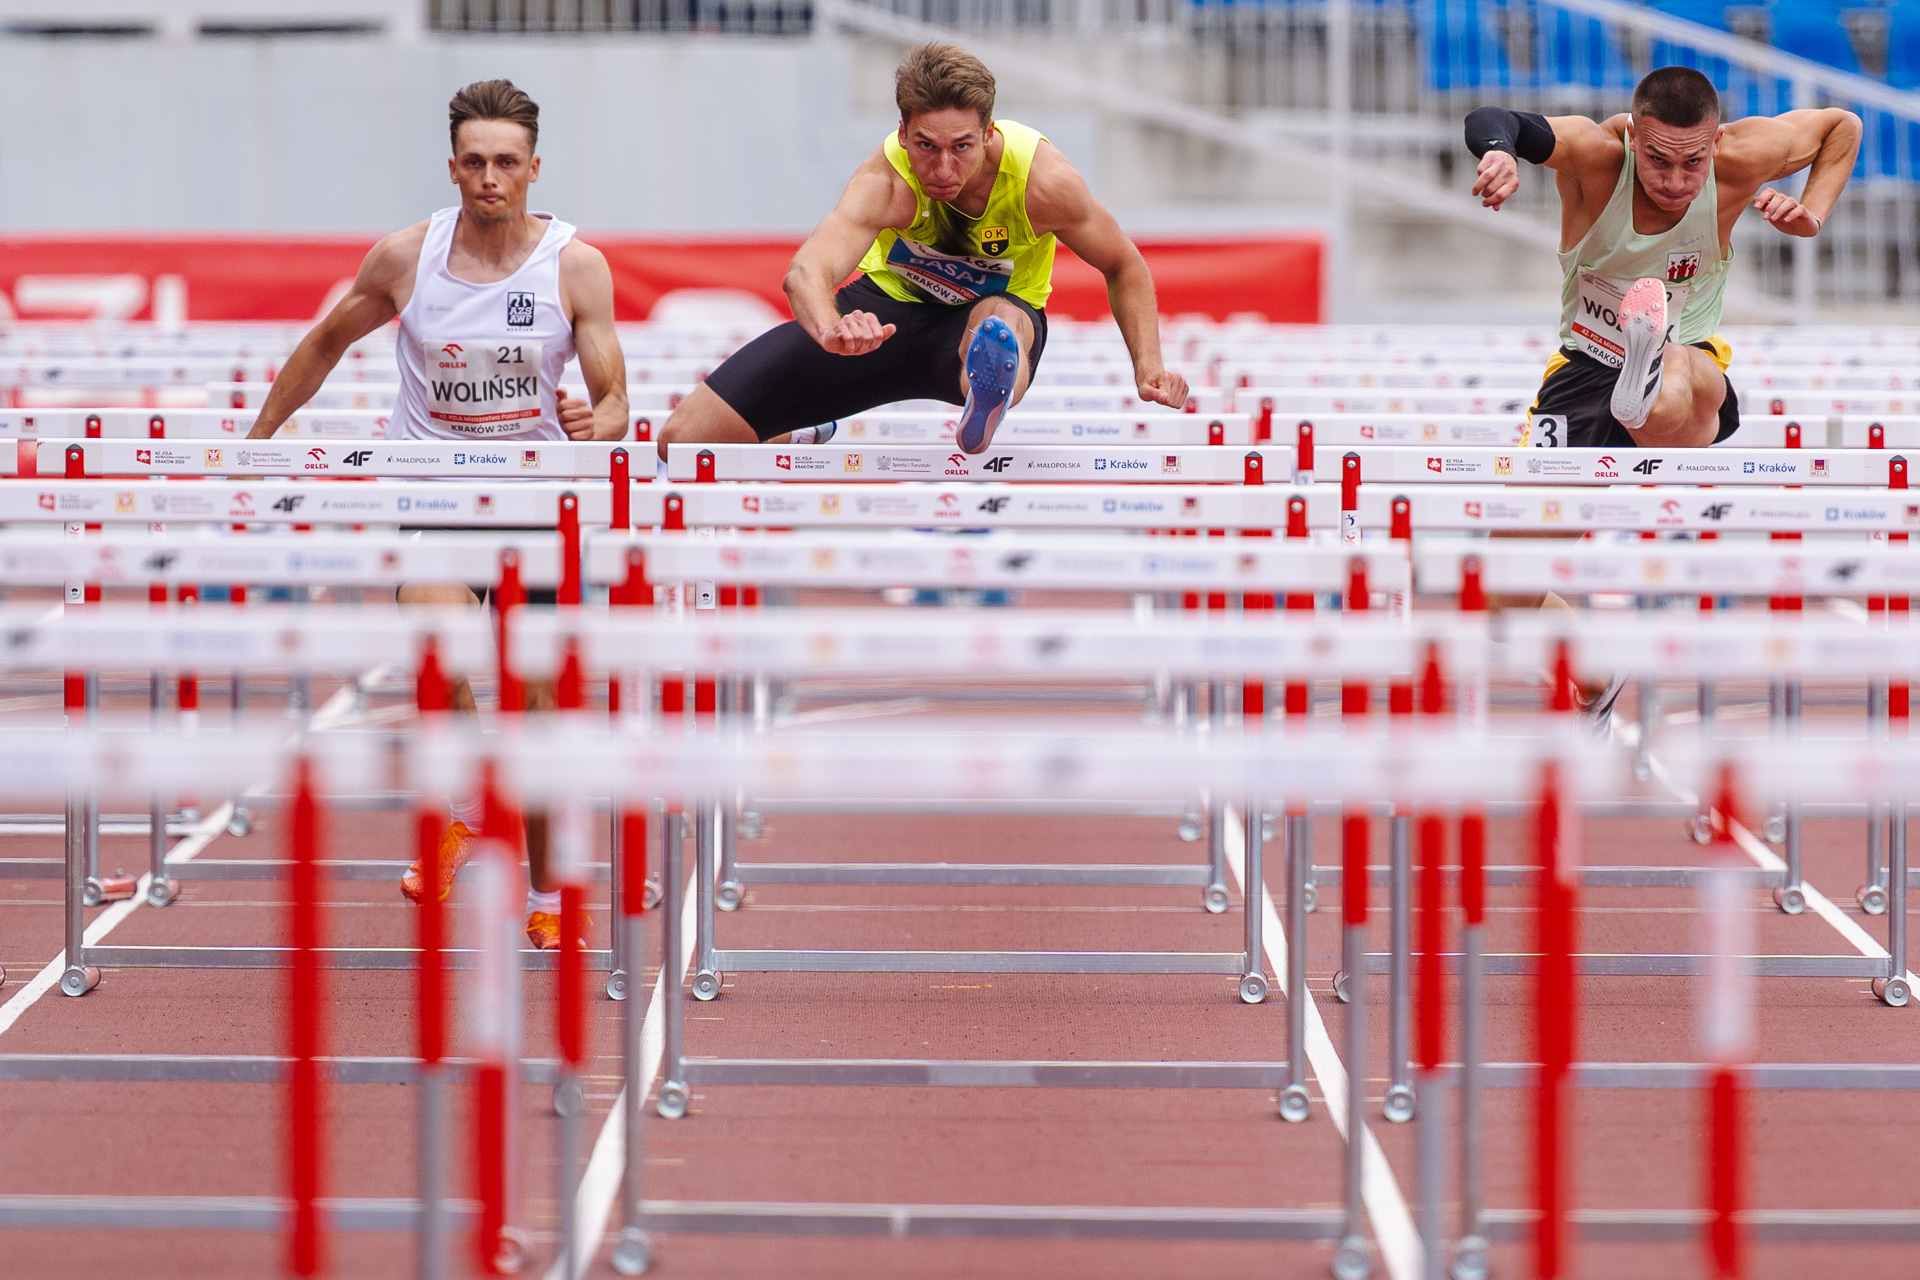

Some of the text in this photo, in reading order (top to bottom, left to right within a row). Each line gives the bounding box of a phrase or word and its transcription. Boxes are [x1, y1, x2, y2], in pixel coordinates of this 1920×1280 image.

[990, 243, 999, 253] S
[905, 271, 951, 299] KRAKÓW
[508, 306, 533, 315] AZS
[508, 314, 533, 324] AWF
[1581, 329, 1590, 337] 42.
[1603, 340, 1624, 356] Mistrzos
[497, 346, 525, 364] 21
[438, 361, 467, 369] ORLEN
[431, 374, 538, 403] WOLIŃSKI
[463, 414, 500, 423] Mistrzostwa
[501, 412, 519, 420] Polski
[450, 422, 521, 434] KRAKÓW 2025
[1535, 418, 1557, 447] 3
[342, 451, 373, 466] 4F
[396, 456, 440, 464] MAŁOPOLSKA
[469, 454, 507, 464] Kraków
[982, 457, 1014, 472] 4F
[1110, 460, 1148, 469] Kraków
[1632, 459, 1663, 475] 4F
[1759, 463, 1796, 473] Kraków
